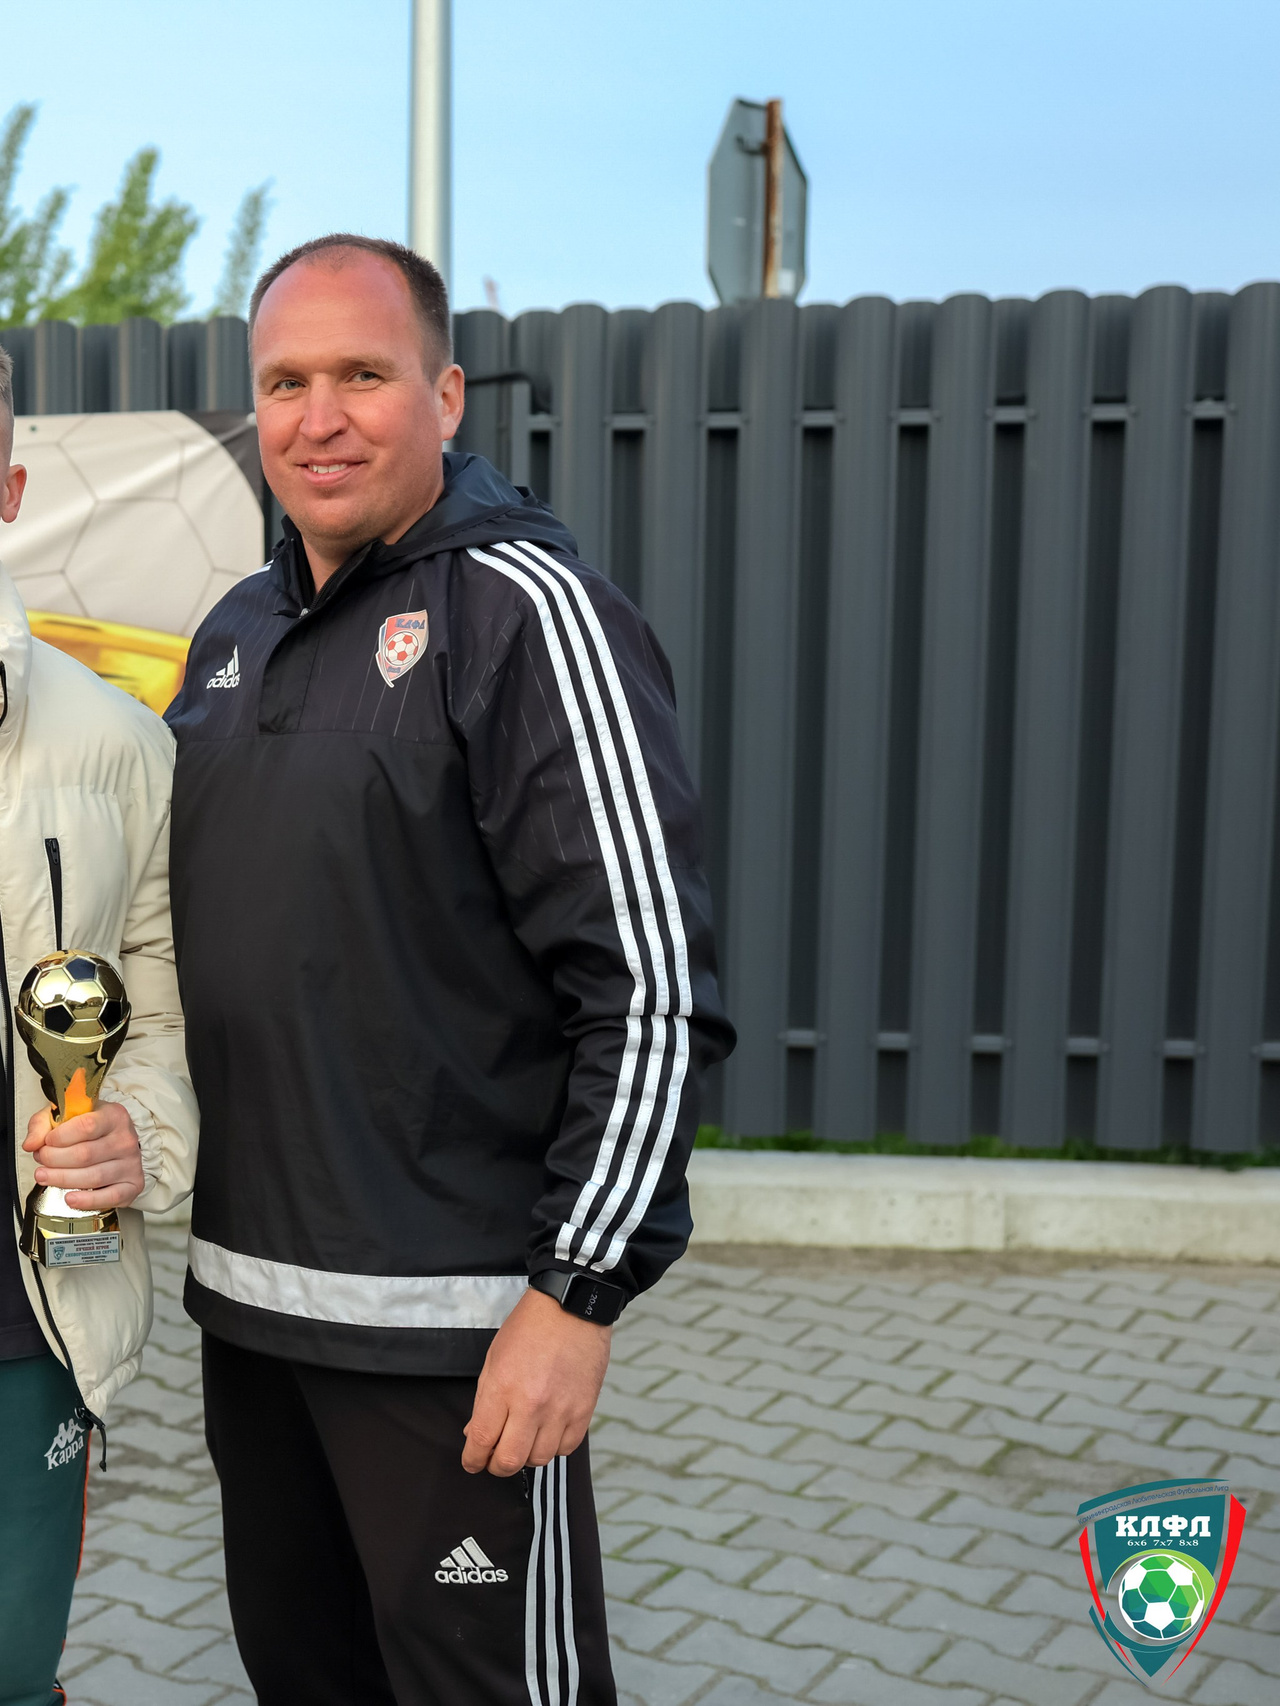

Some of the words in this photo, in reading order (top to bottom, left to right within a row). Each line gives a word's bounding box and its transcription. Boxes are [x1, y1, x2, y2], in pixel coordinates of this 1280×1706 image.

[206, 673, 241, 689] adidas
[585, 1293, 598, 1316] 20:42
[47, 1435, 84, 1470] Kappa
[434, 1566, 509, 1584] adidas
